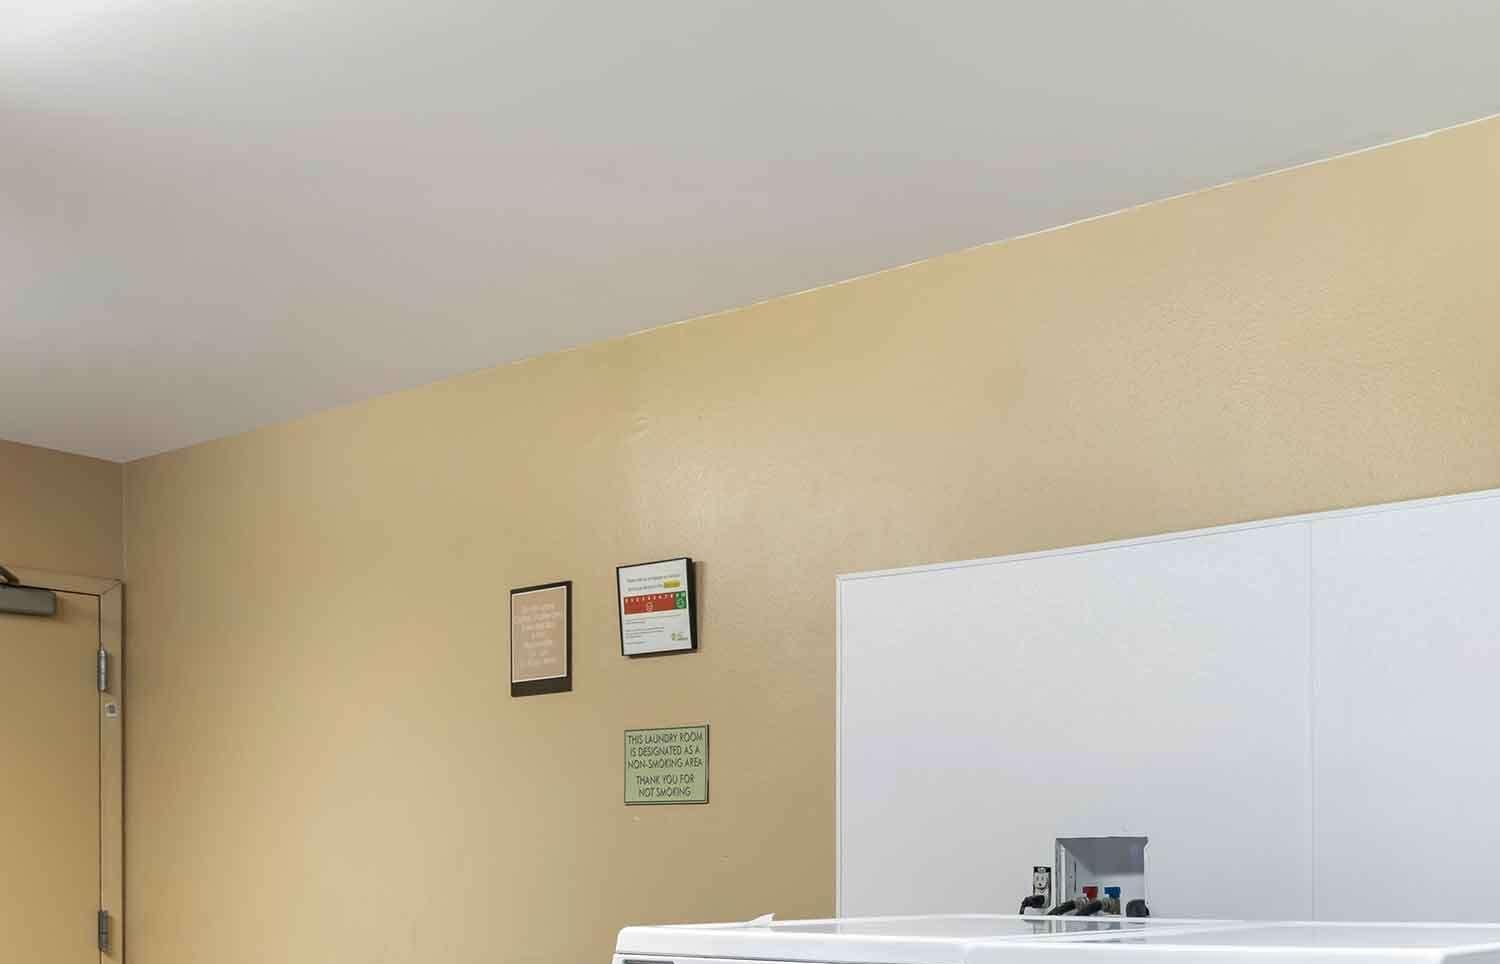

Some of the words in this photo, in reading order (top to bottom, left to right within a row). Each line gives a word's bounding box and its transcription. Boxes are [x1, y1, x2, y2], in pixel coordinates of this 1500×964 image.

[628, 735, 643, 744] THIS
[645, 733, 678, 743] LAUNDRY
[680, 731, 703, 742] ROOM
[638, 745, 682, 756] DESIGNATED
[684, 745, 693, 754] AS
[628, 759, 683, 769] NON-SMOKING
[685, 757, 703, 767] AREA
[636, 775, 660, 785] THANK
[663, 774, 678, 784] YOU
[680, 773, 694, 783] FOR
[639, 787, 655, 797] NOT
[656, 787, 691, 797] SMOKING
